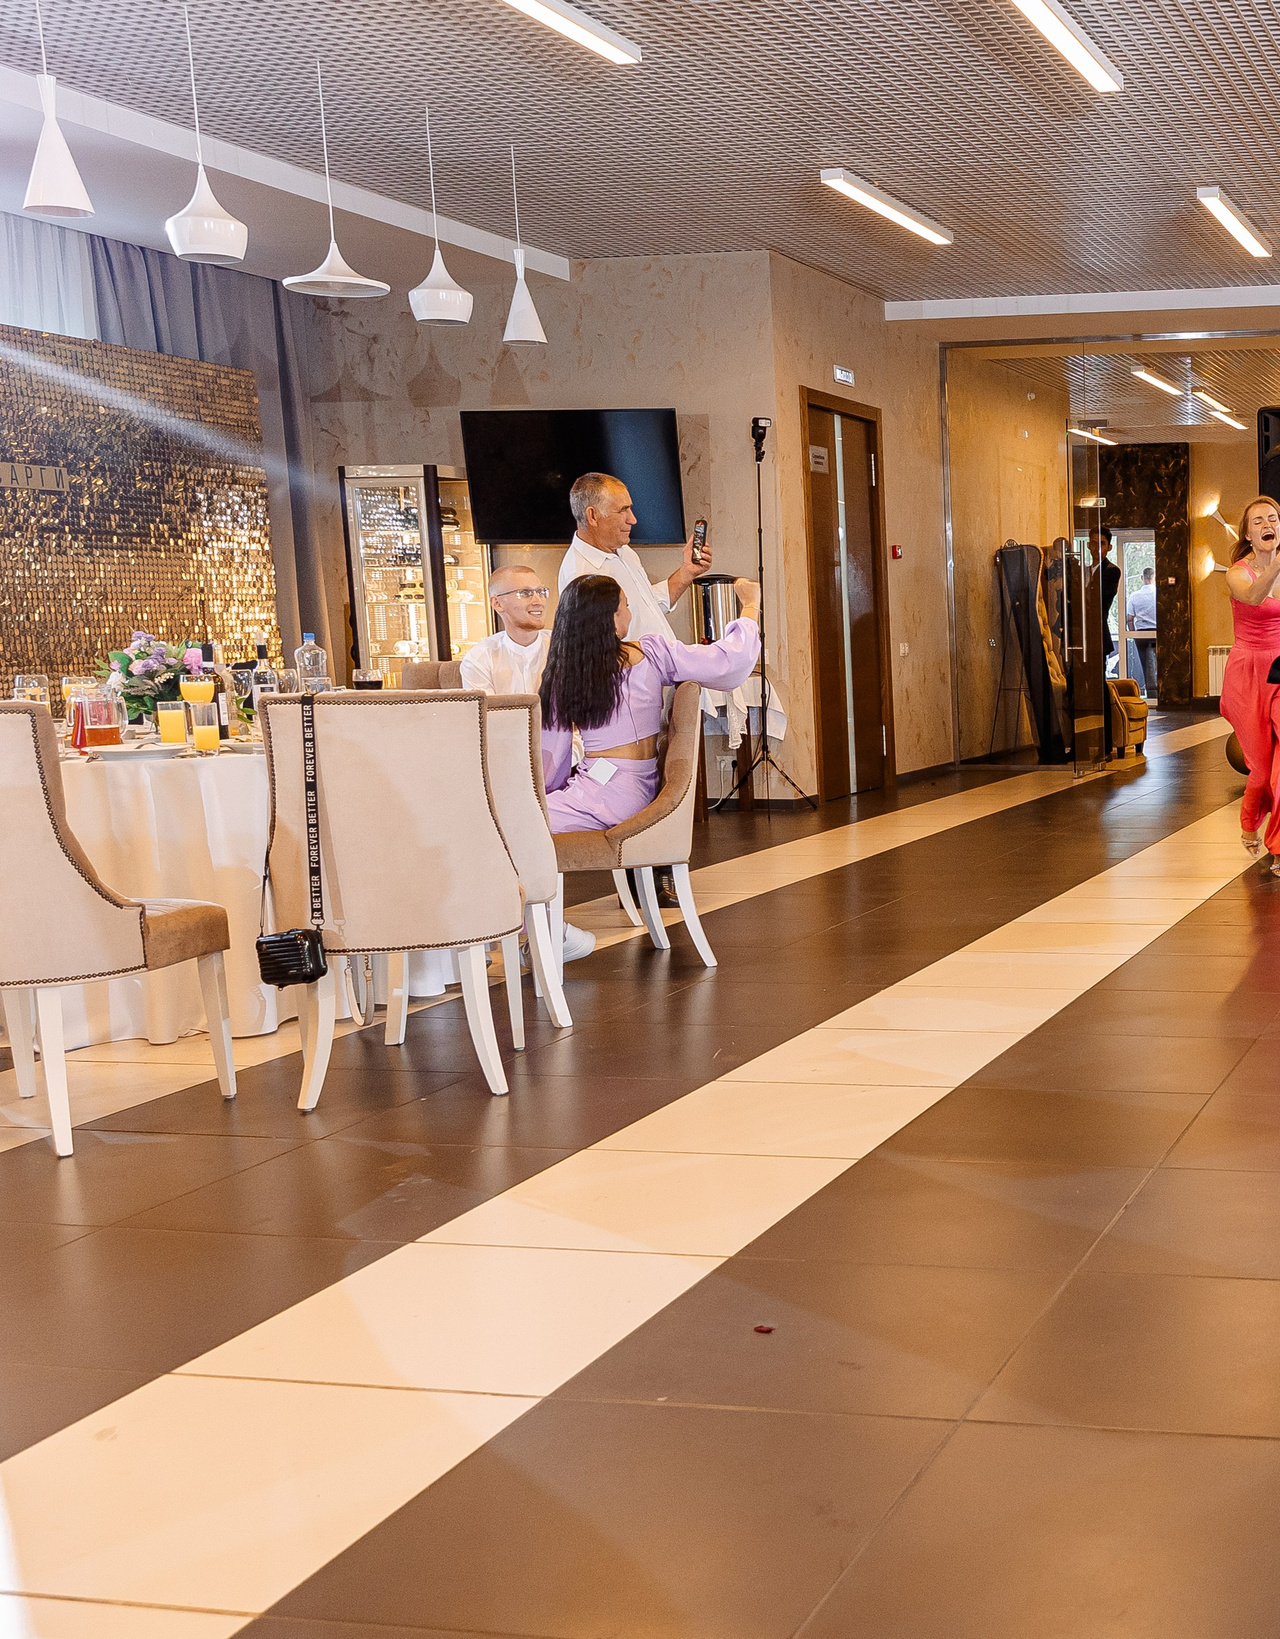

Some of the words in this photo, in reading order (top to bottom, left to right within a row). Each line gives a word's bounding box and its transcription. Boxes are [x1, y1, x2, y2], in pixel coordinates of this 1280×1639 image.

[0, 464, 65, 489] АРГИ
[303, 704, 314, 739] BETTER
[305, 741, 315, 782] FOREVER
[307, 790, 317, 824] BETTER
[309, 827, 319, 867] FOREVER
[311, 875, 322, 908] BETTER
